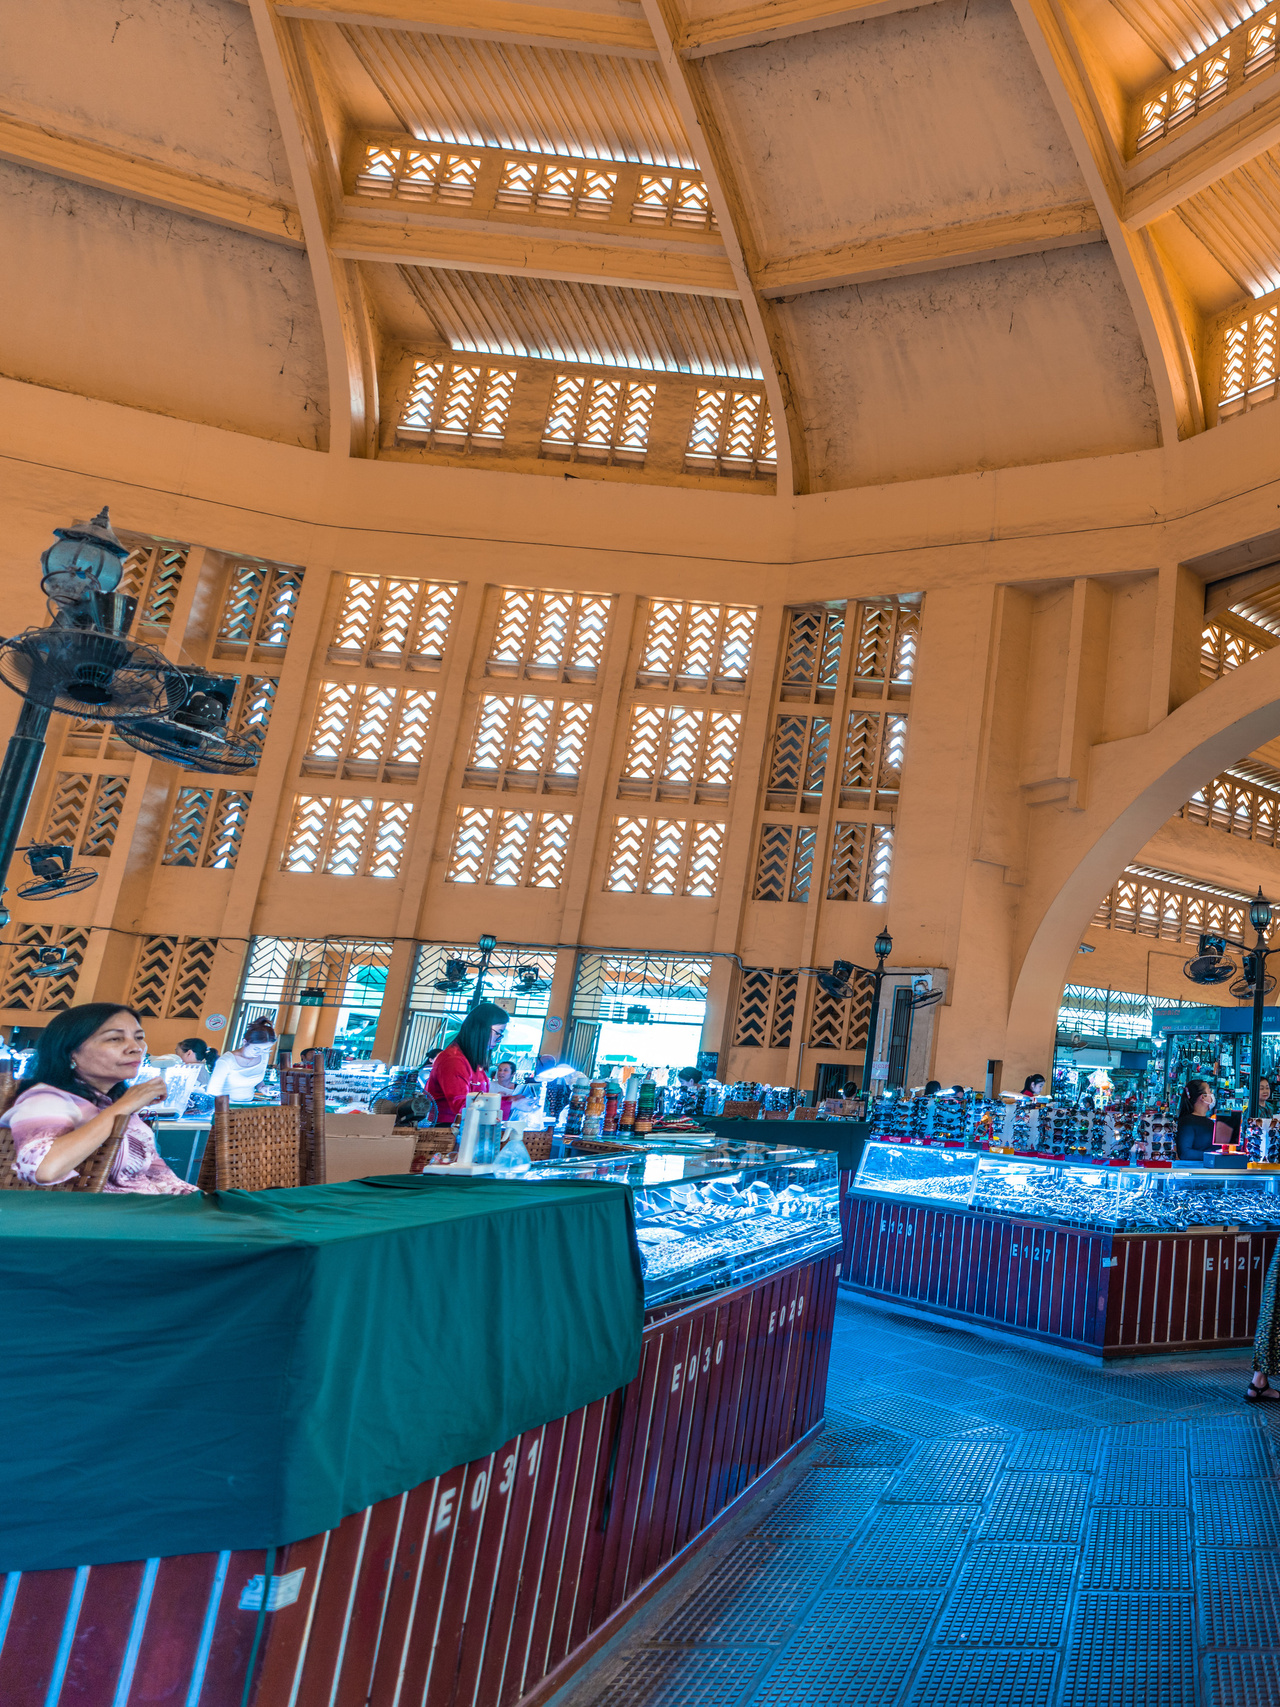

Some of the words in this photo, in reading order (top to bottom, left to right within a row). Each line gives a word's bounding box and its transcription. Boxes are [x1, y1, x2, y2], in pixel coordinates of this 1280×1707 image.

[1012, 1243, 1051, 1263] E127
[1205, 1256, 1260, 1271] E127
[768, 1296, 804, 1334] E029
[671, 1339, 724, 1393] E030
[434, 1439, 540, 1535] E031
